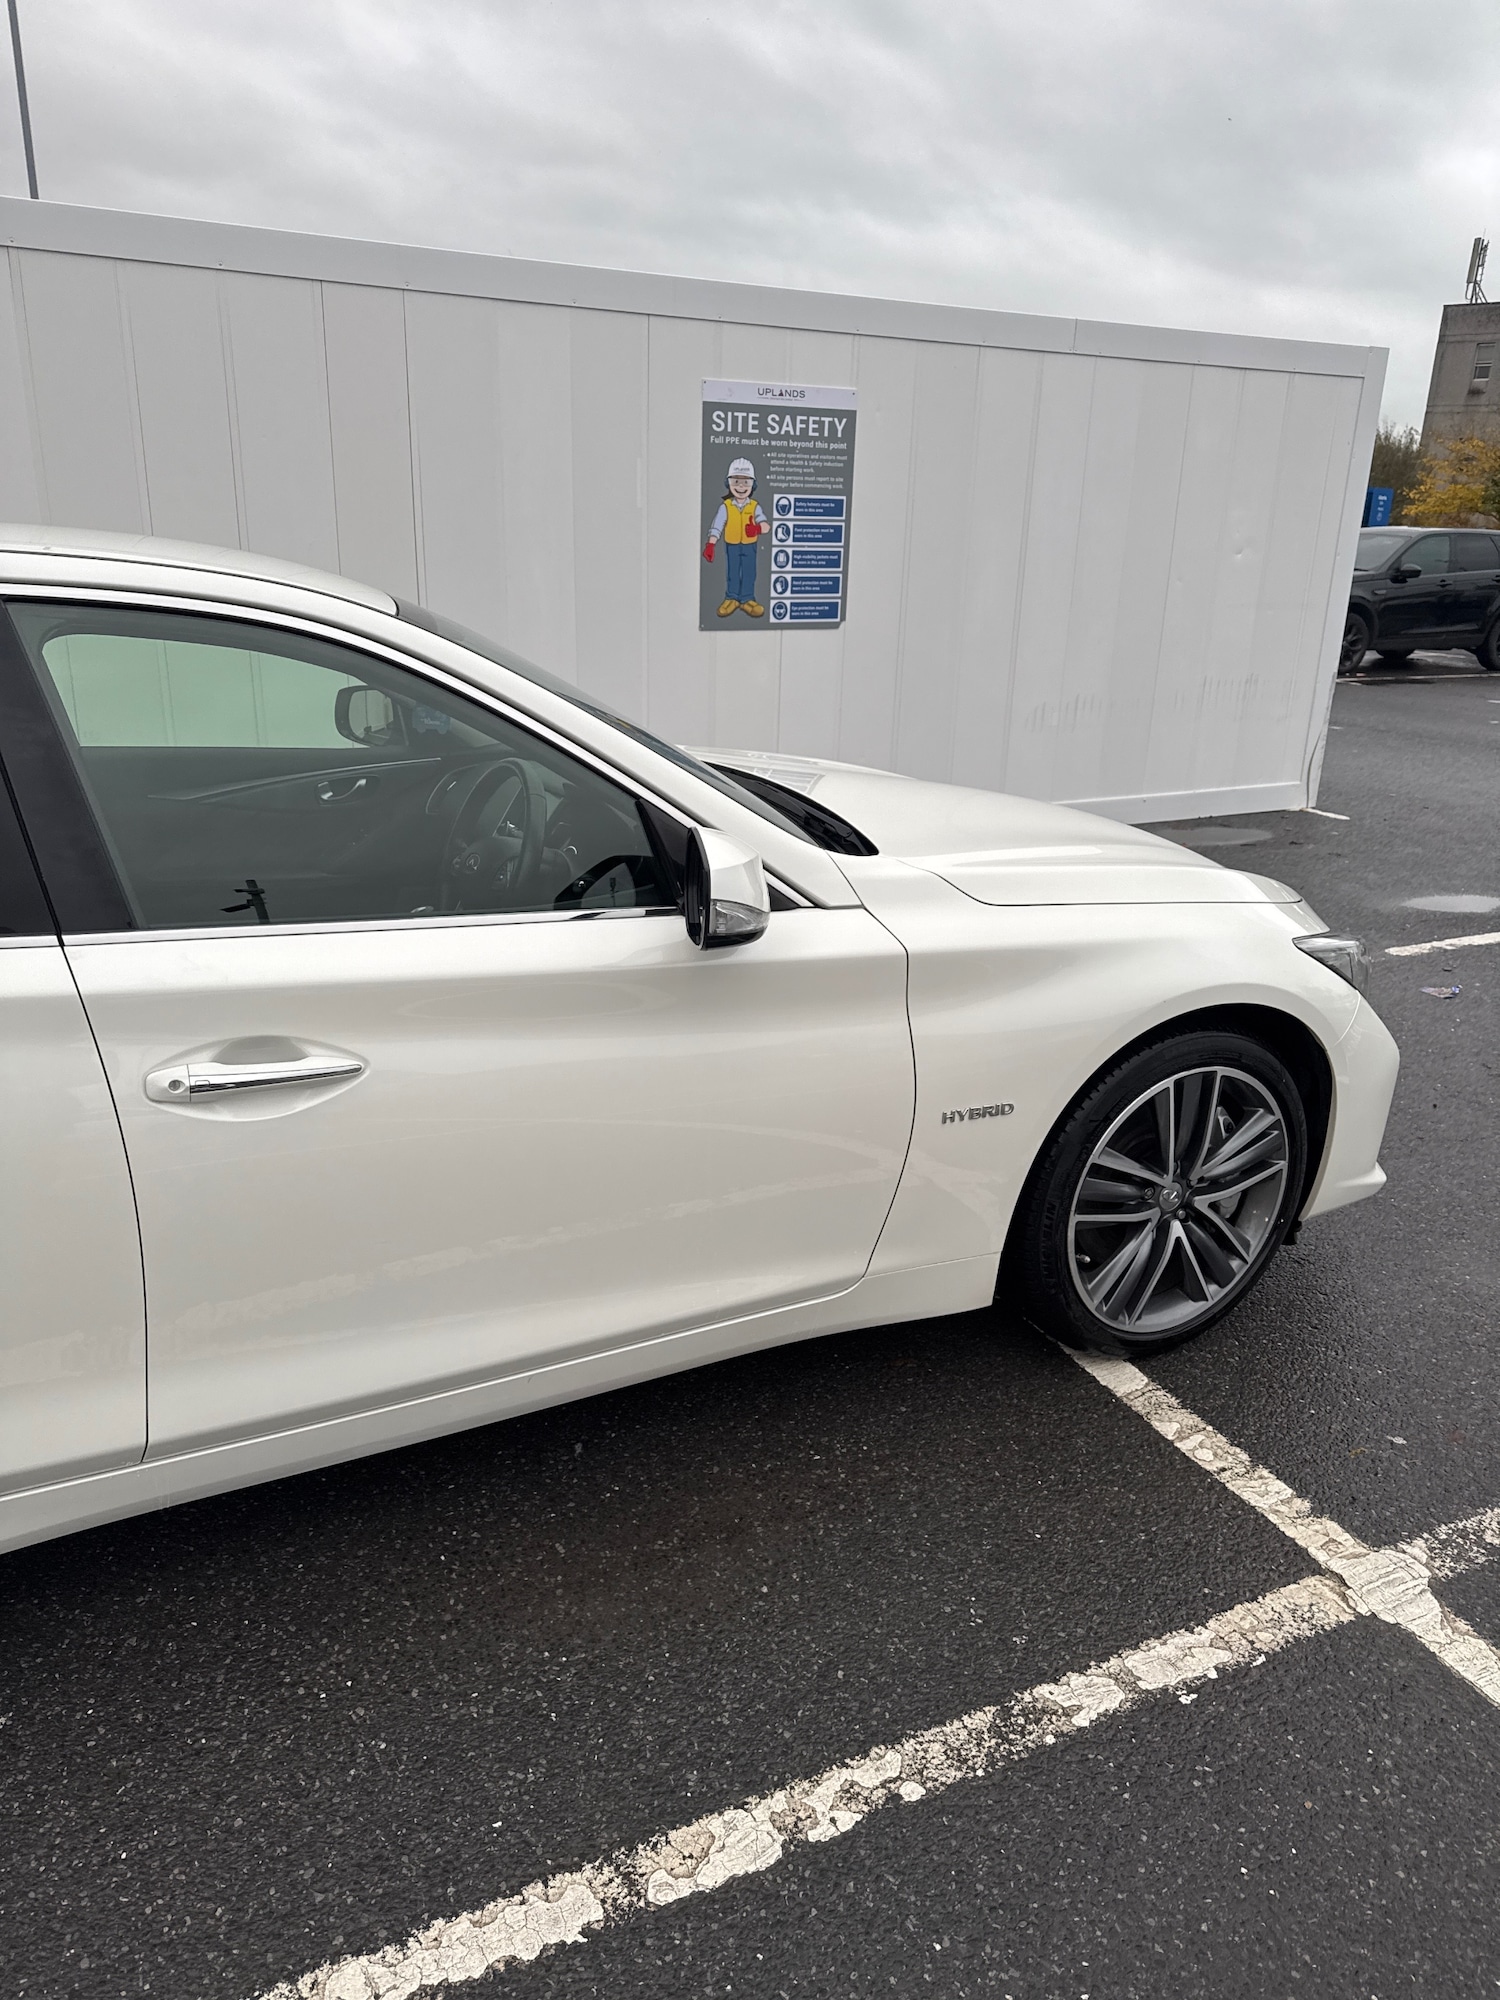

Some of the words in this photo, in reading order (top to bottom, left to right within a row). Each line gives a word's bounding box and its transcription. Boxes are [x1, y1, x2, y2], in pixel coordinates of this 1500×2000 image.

[757, 388, 806, 398] UPLANDS
[712, 410, 760, 434] SITE
[766, 414, 848, 438] SAFETY
[710, 435, 724, 444] Full
[726, 437, 740, 445] PPE
[741, 438, 759, 446] must
[760, 438, 770, 446] be
[789, 440, 814, 450] beyond
[815, 440, 828, 449] this
[830, 442, 847, 450] point
[942, 1102, 1014, 1124] HYBRID
